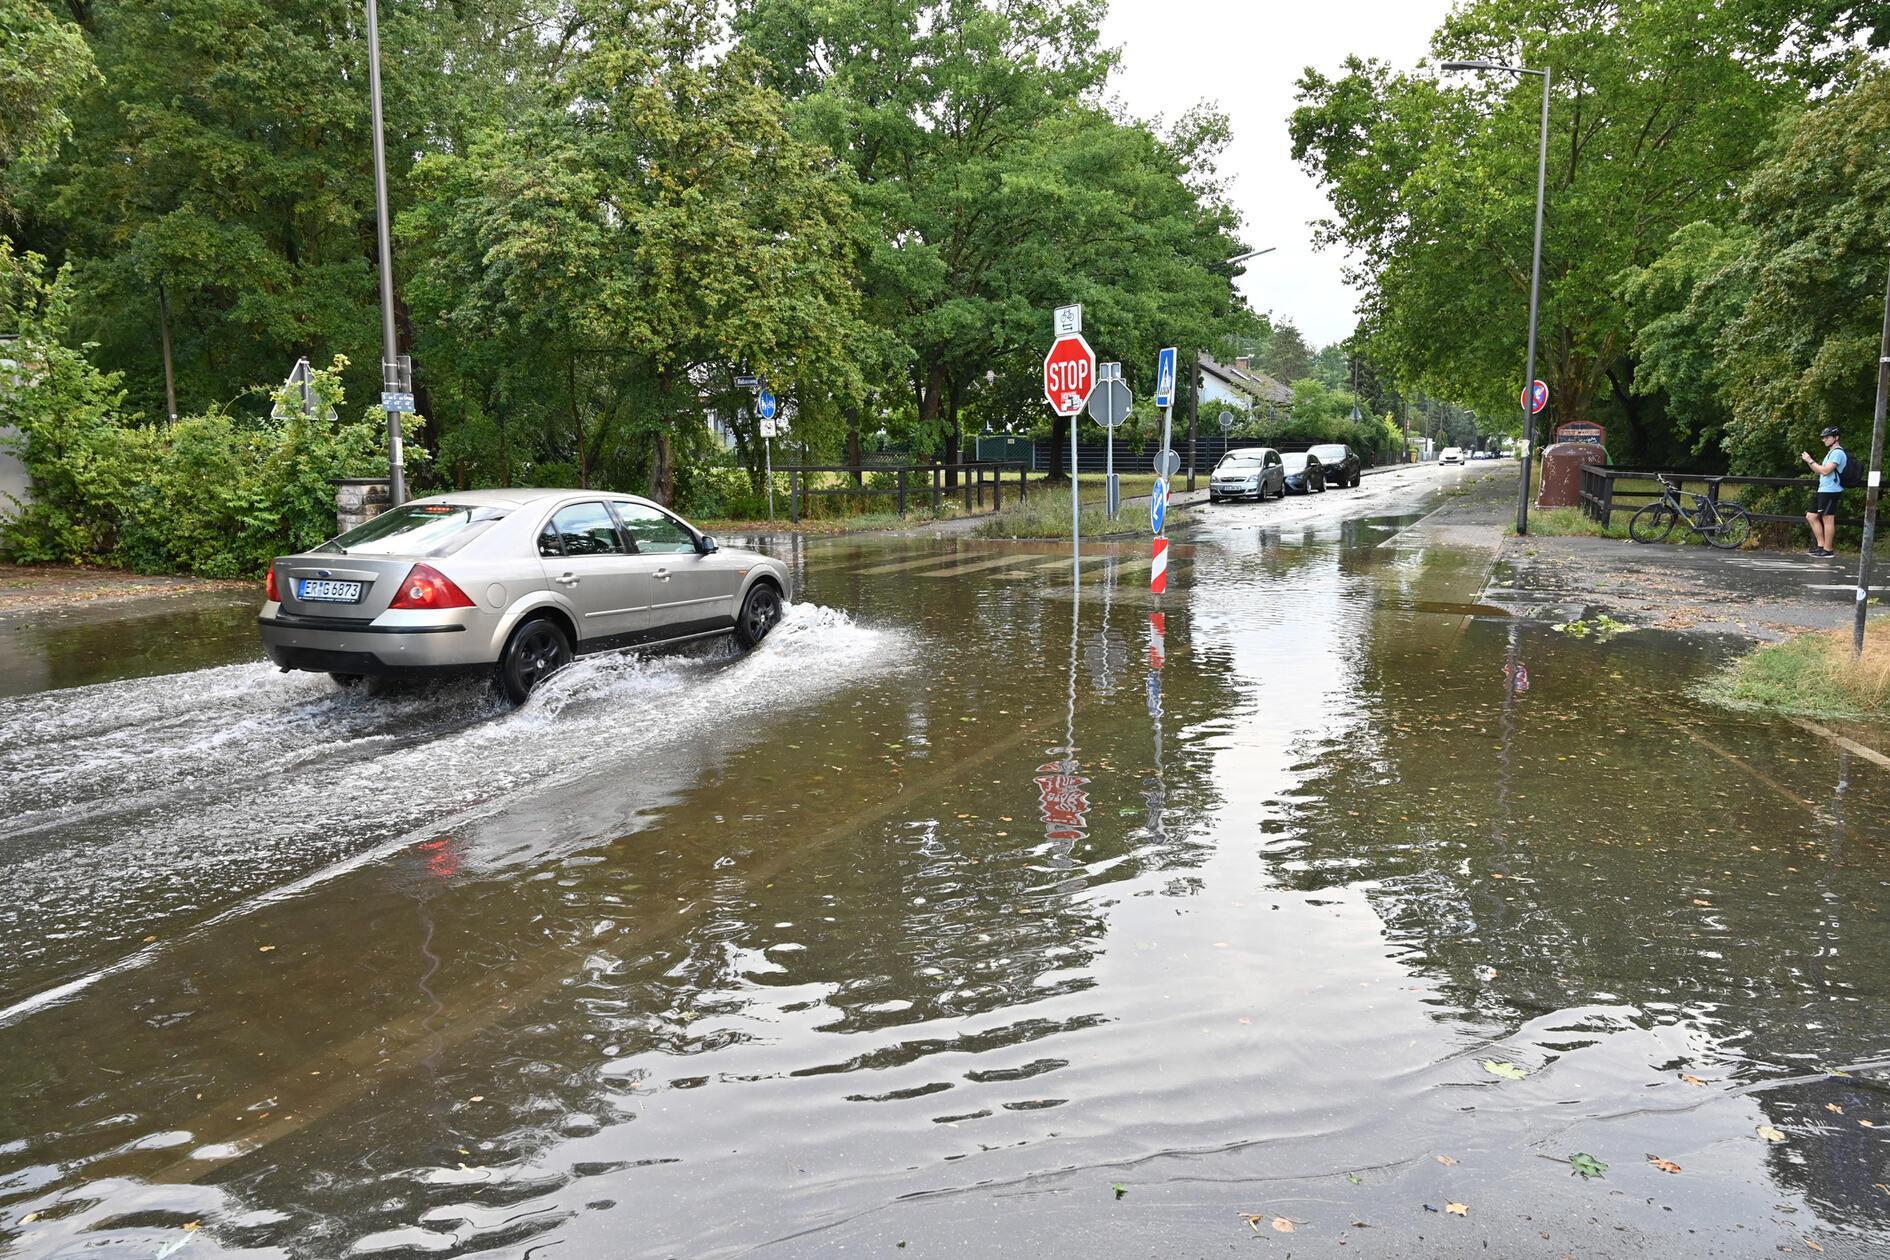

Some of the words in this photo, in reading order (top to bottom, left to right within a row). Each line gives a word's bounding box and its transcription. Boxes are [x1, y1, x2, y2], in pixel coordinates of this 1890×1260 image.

[1049, 359, 1088, 391] STOP
[305, 581, 318, 595] ER
[331, 583, 359, 597] 6873
